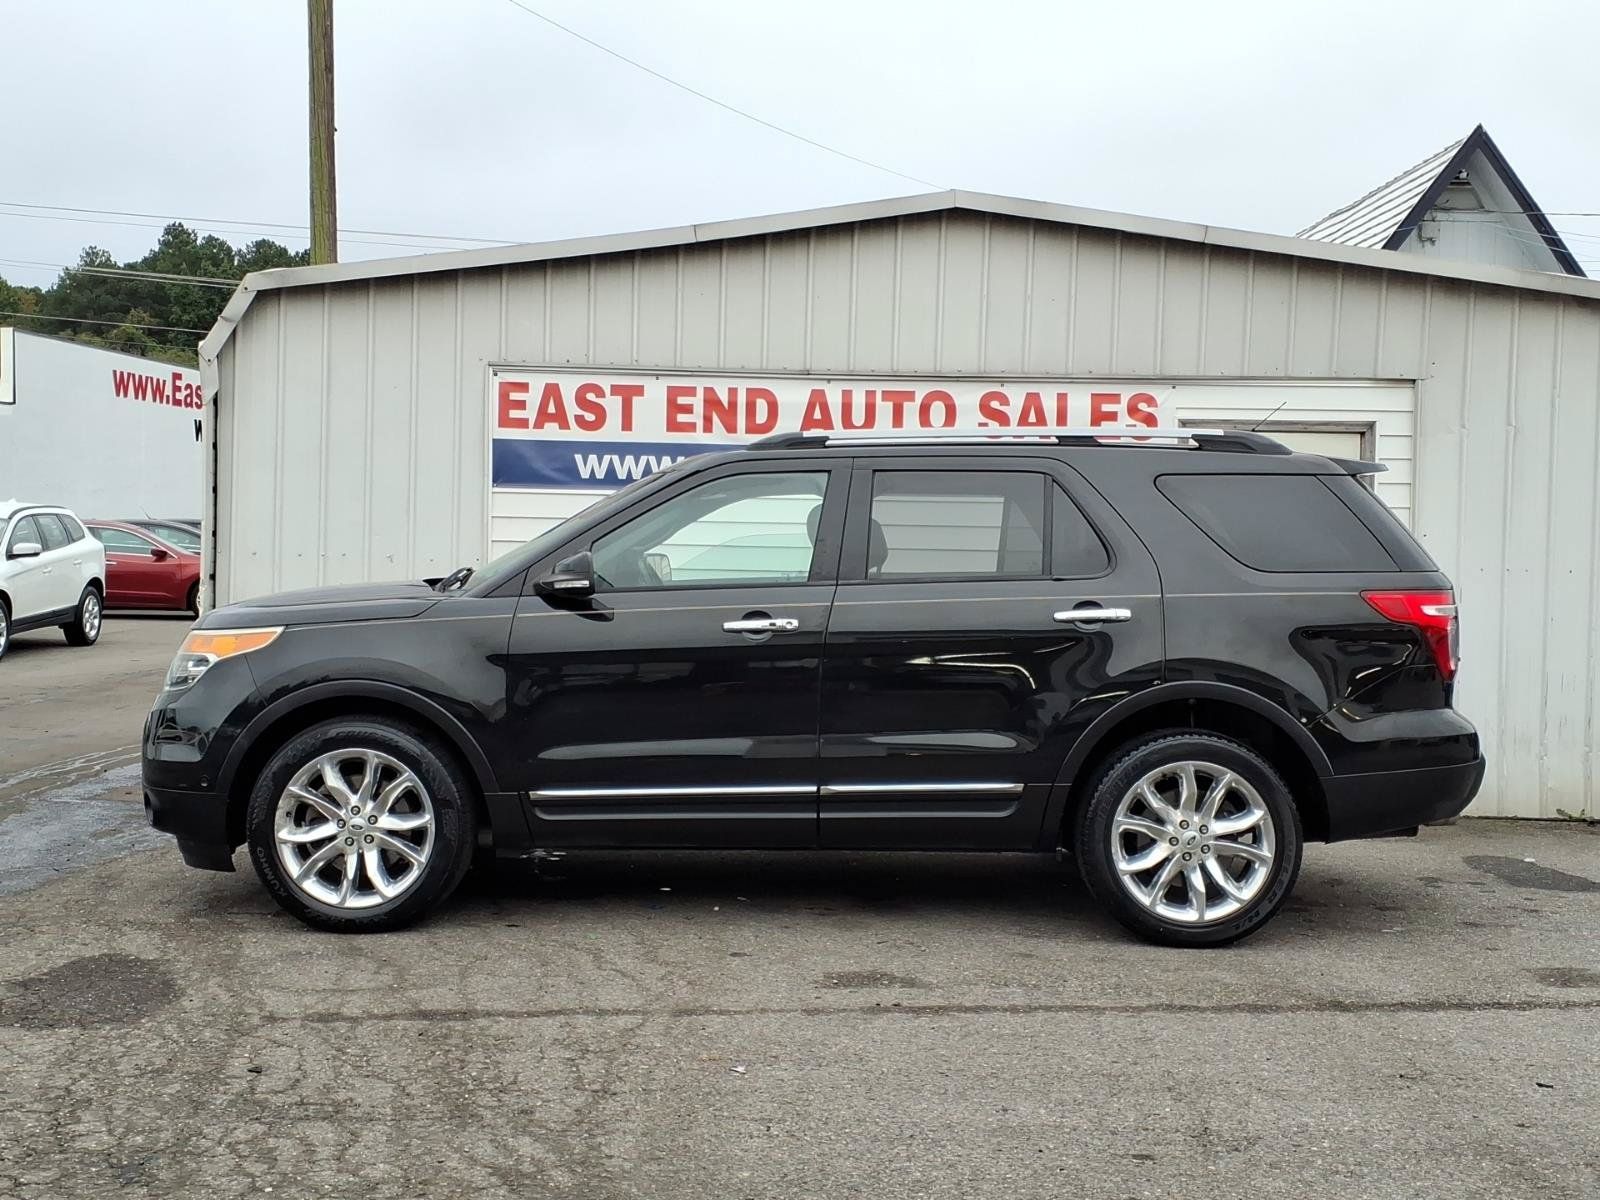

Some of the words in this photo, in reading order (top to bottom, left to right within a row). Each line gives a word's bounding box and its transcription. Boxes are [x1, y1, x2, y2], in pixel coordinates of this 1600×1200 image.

[498, 381, 645, 432] EAST
[665, 386, 779, 435] END
[800, 388, 957, 432] AUTO
[978, 391, 1159, 441] SALES
[257, 847, 288, 897] KUMHO
